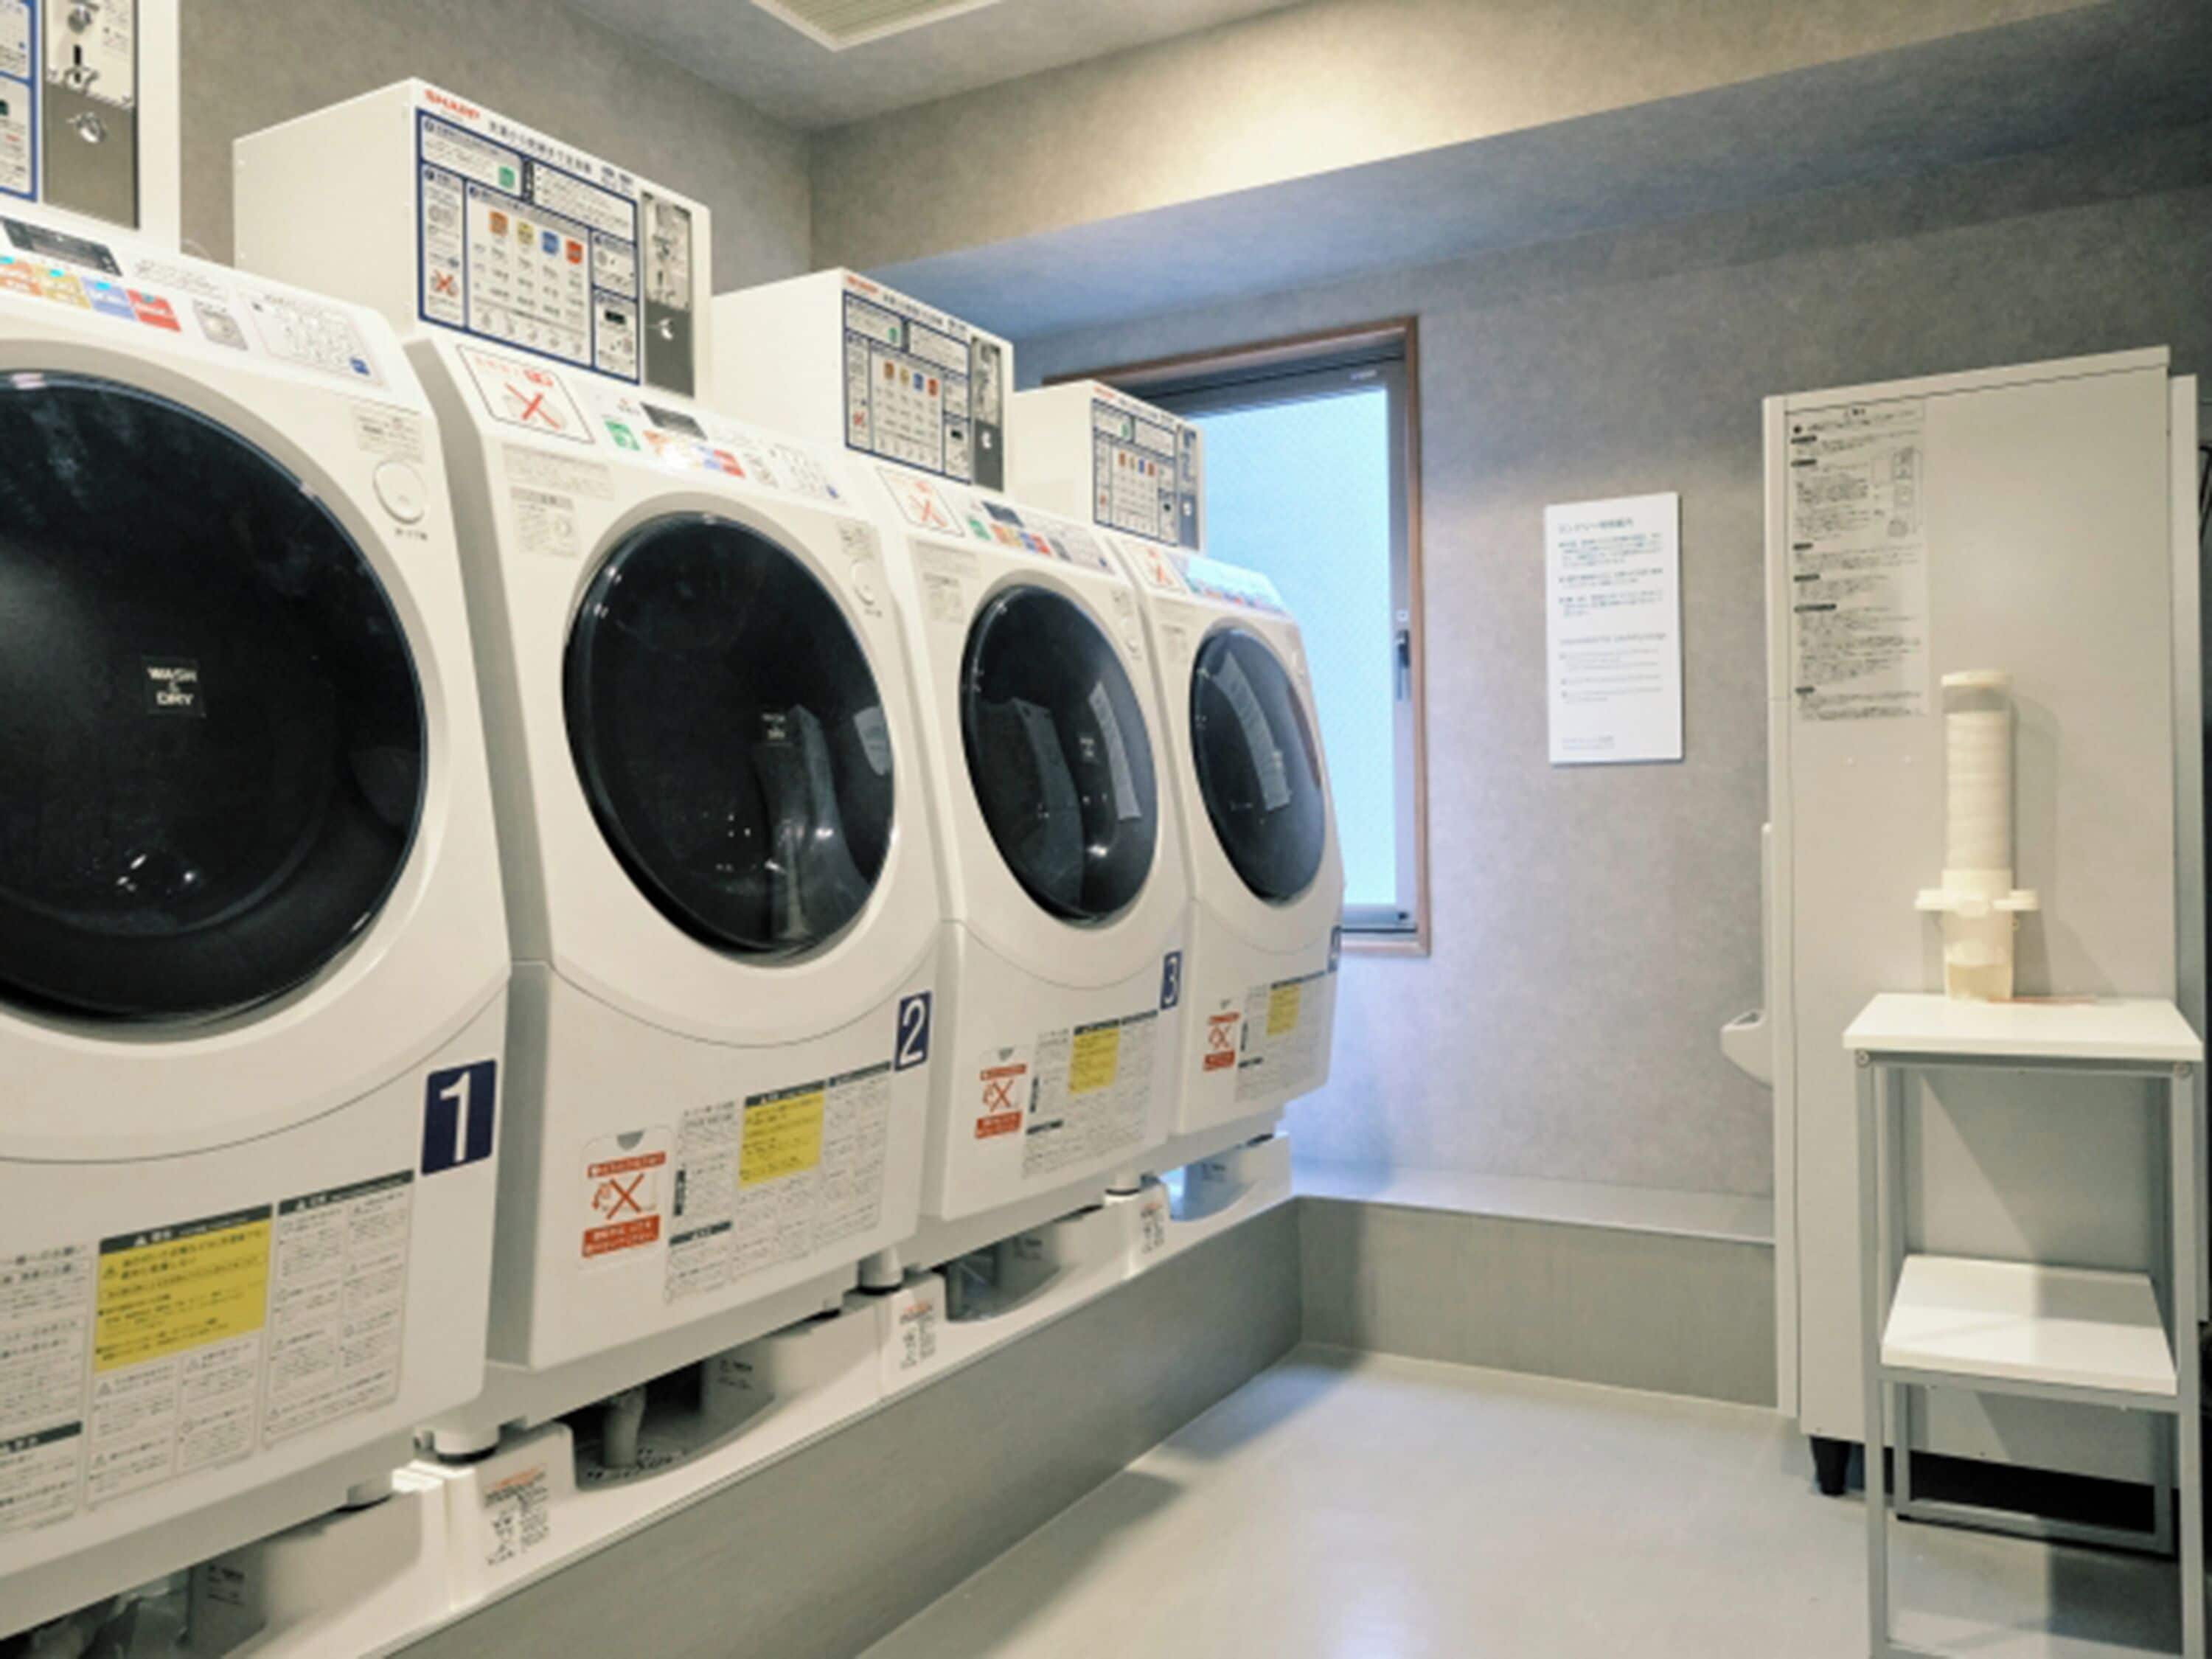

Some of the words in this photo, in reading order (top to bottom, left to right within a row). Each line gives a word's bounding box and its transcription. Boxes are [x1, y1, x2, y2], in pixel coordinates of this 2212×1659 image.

[156, 692, 194, 706] DRY
[1164, 956, 1178, 1004] 3
[900, 999, 925, 1065] 2
[440, 1071, 470, 1163] 1
